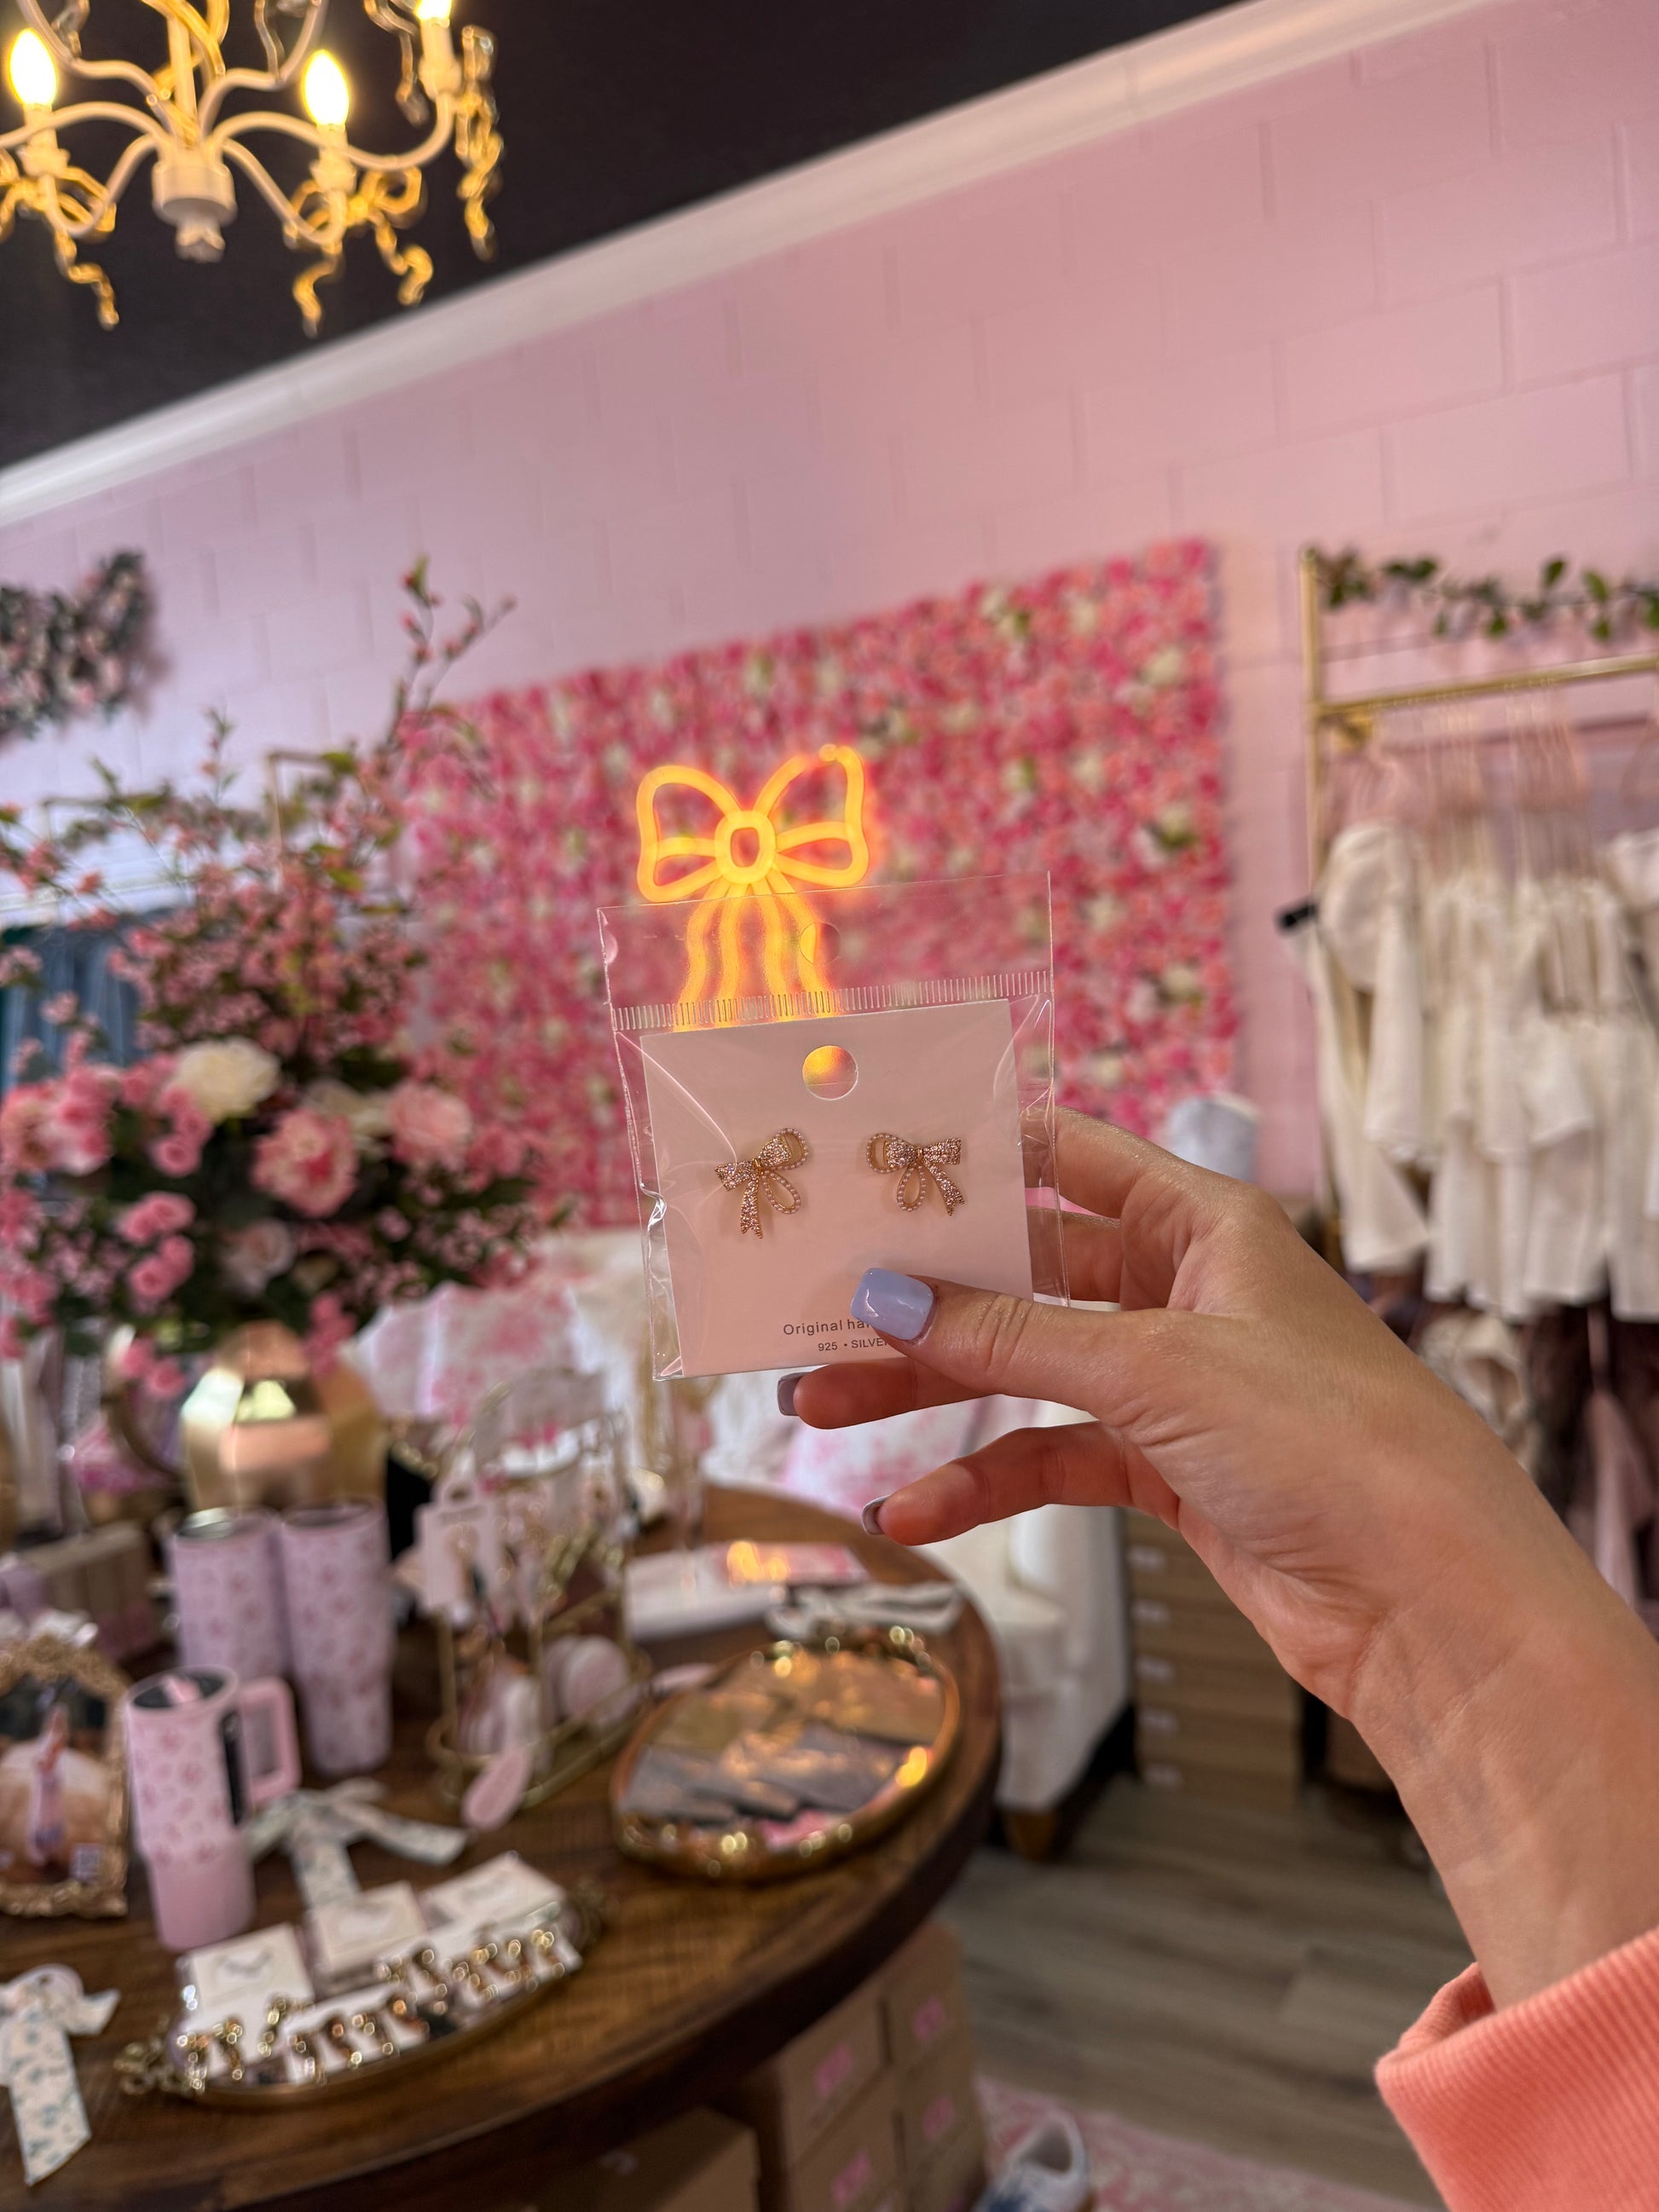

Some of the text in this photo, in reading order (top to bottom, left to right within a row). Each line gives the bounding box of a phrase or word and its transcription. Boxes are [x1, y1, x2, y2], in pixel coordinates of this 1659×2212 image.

[783, 1320, 843, 1336] Original
[818, 1337, 887, 1352] 925 SILVE
